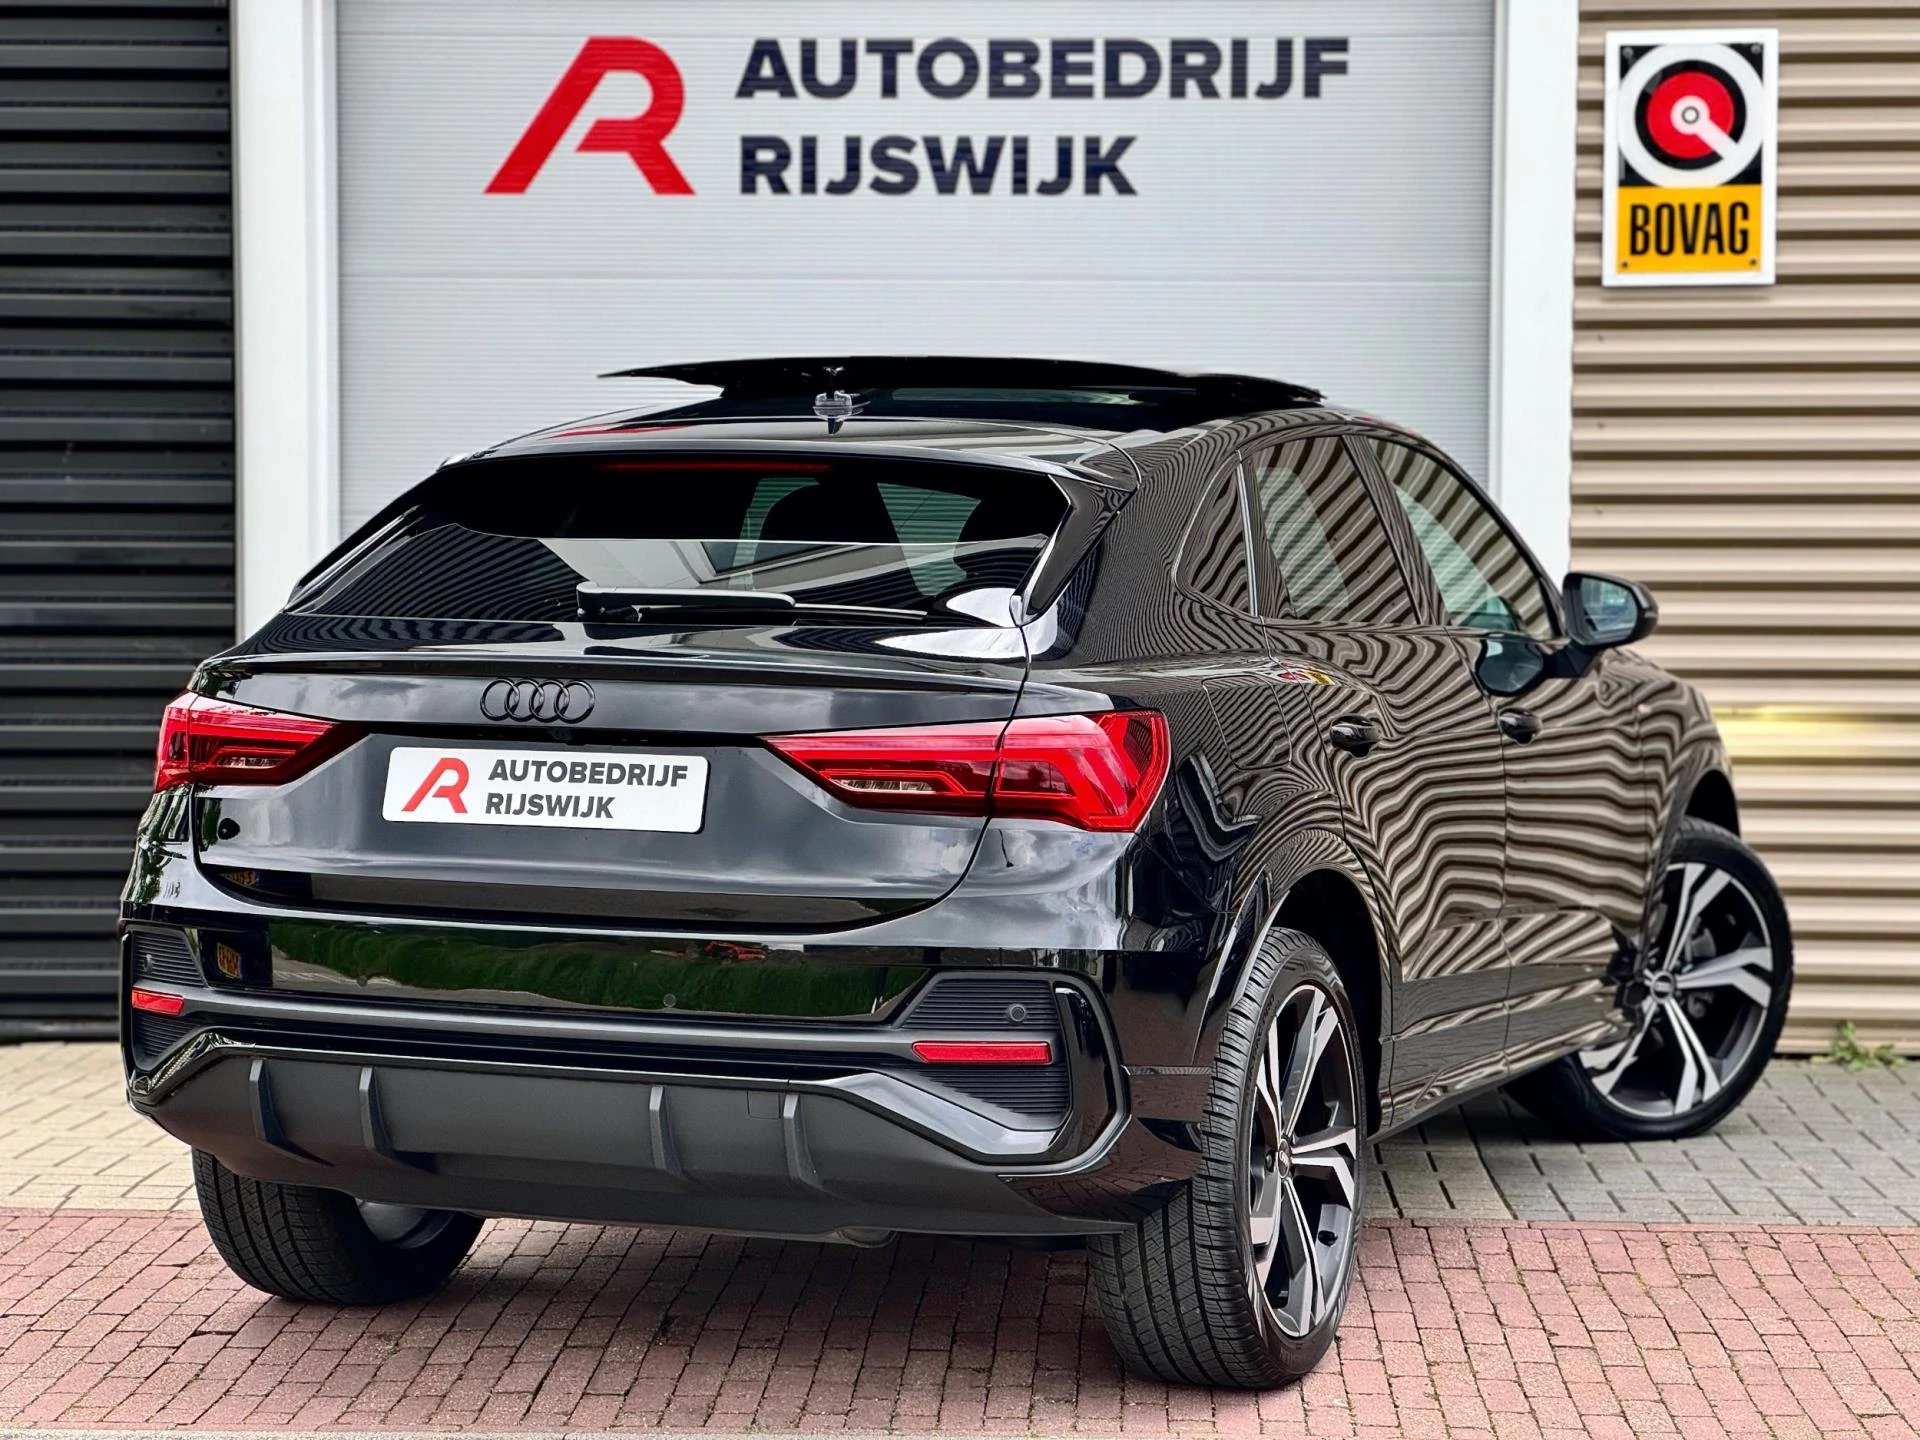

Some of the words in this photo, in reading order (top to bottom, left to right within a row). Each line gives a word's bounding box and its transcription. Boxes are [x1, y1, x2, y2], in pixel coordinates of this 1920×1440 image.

[735, 37, 1349, 100] AUTOBEDRIJF
[740, 135, 1138, 196] RIJSWIJK
[1630, 201, 1749, 256] BOVAG
[488, 758, 688, 787] AUTOBEDRIJF
[485, 792, 615, 819] RIJSWIJK
